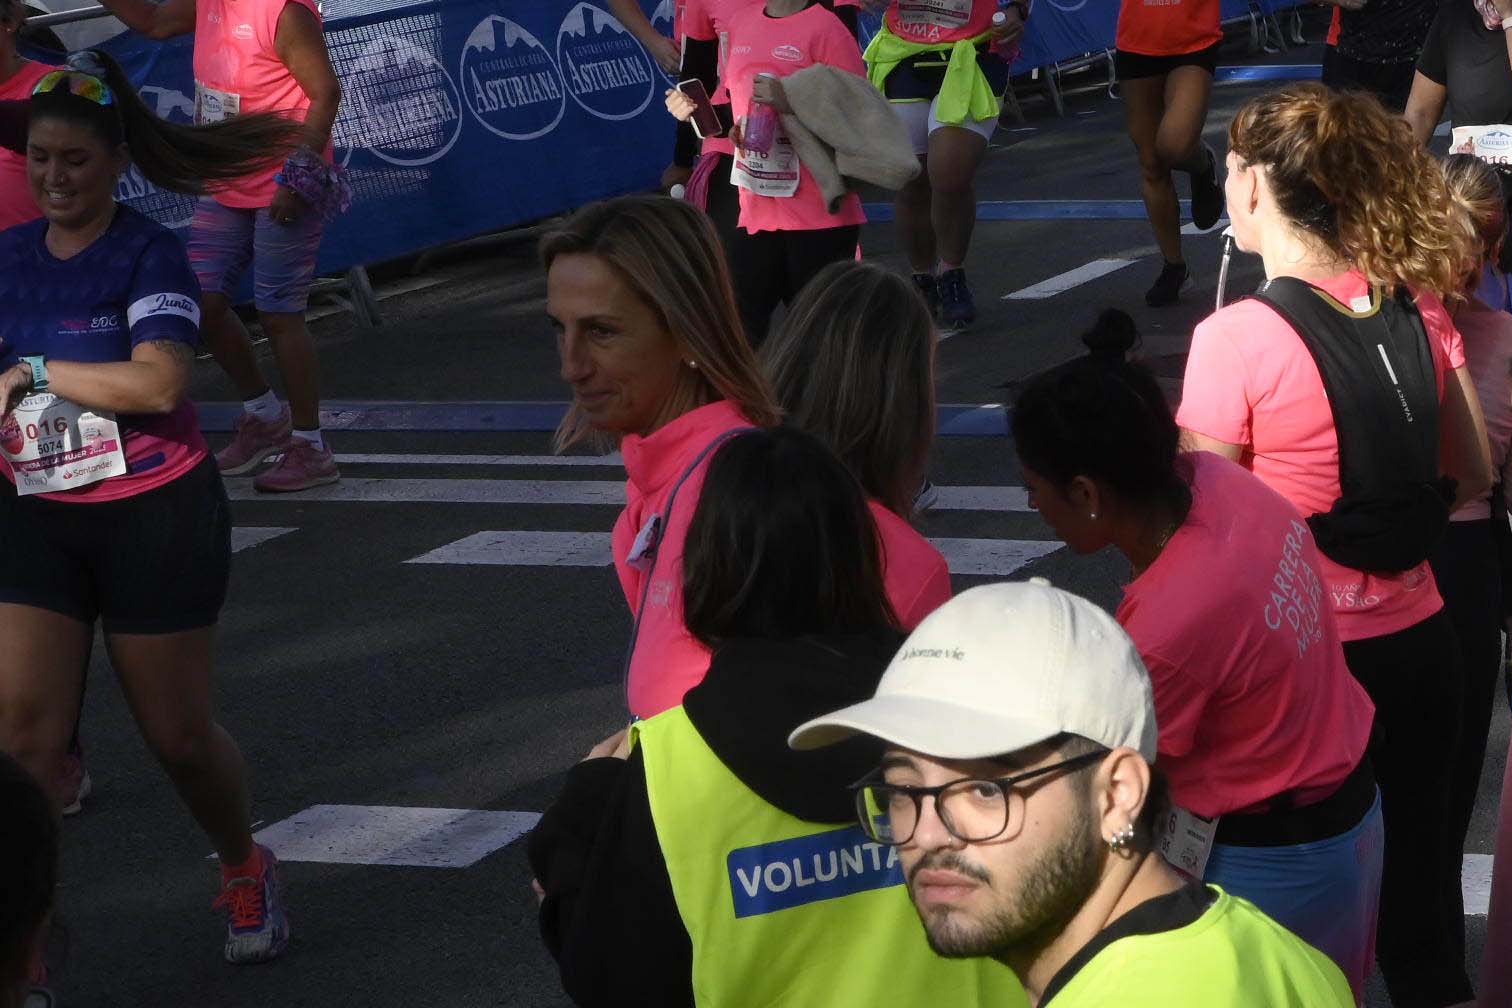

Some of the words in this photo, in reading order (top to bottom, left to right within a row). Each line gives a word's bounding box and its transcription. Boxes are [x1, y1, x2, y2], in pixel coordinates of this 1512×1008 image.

[569, 50, 649, 95] ASTURIANA
[472, 65, 562, 114] ASTURIANA
[26, 416, 69, 440] 016
[37, 439, 63, 455] 5074
[73, 460, 113, 478] Santander
[1264, 519, 1308, 630] CARRERA
[1331, 593, 1380, 608] YSHO
